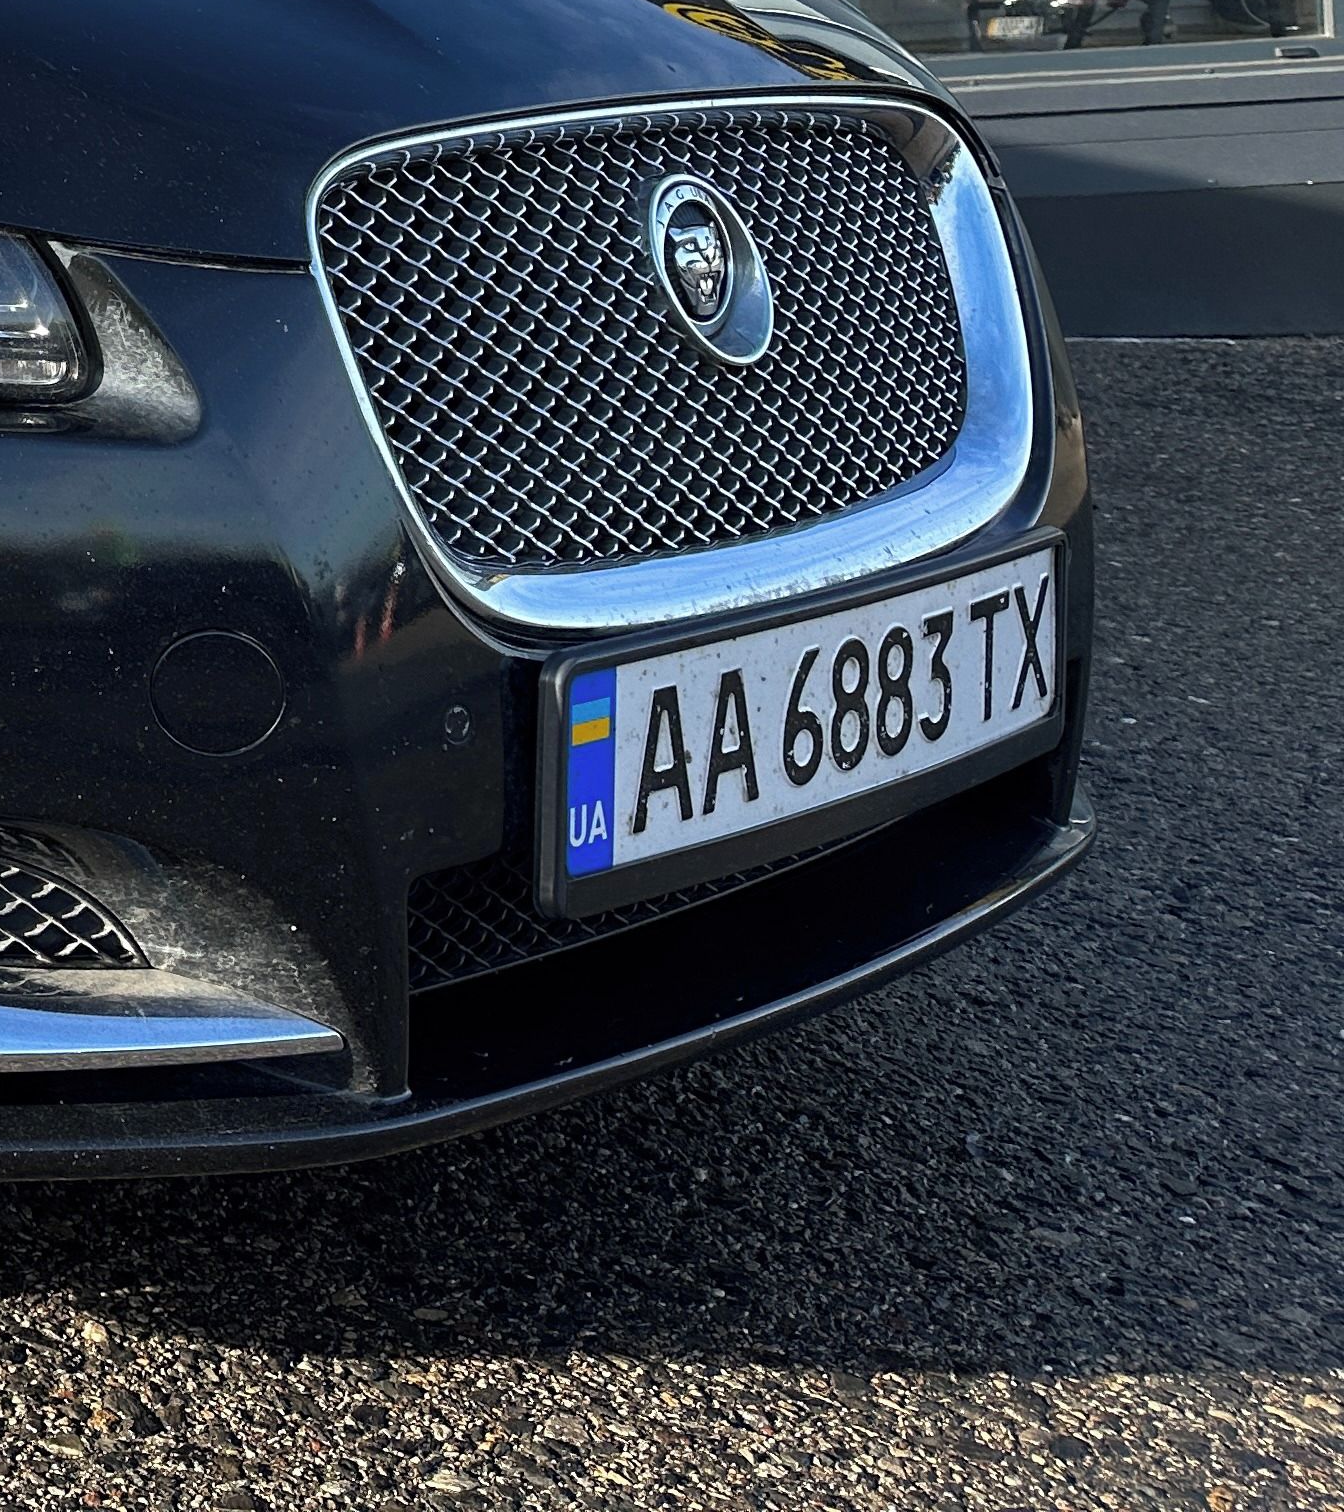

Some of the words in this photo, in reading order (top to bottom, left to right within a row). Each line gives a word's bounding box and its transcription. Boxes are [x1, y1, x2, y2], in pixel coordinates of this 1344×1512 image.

[632, 667, 760, 835] AA
[781, 609, 955, 788] 6883
[969, 573, 1051, 721] TX
[568, 799, 608, 848] UA
